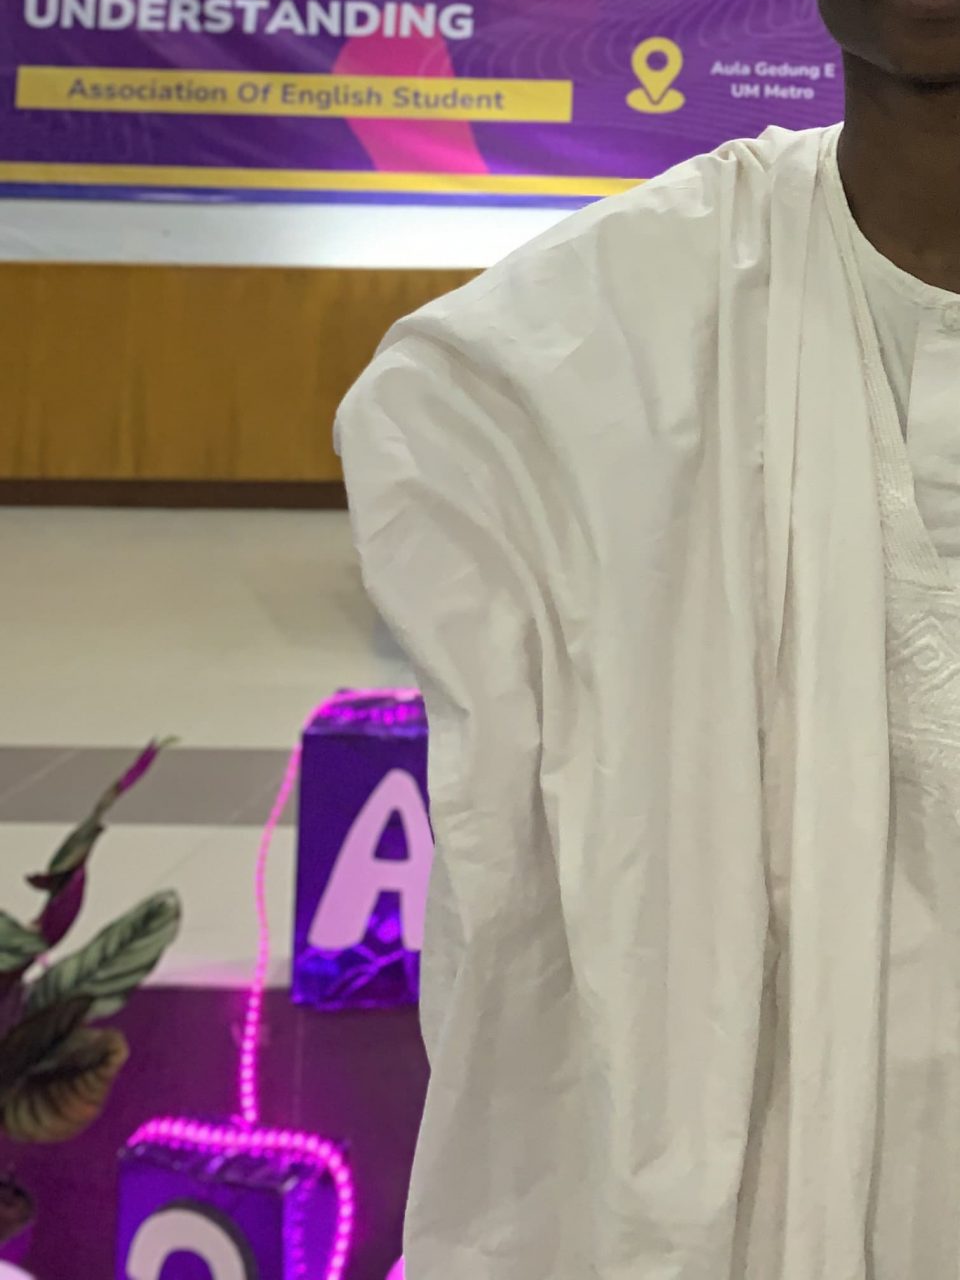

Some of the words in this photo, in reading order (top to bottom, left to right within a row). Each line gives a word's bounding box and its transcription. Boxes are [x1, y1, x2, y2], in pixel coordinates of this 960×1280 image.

[710, 61, 751, 76] Aula
[754, 61, 820, 80] Gedung
[824, 63, 835, 78] E
[67, 77, 227, 104] Association
[237, 83, 270, 104] Of
[281, 83, 383, 109] English
[393, 86, 505, 110] Student
[731, 83, 760, 98] UM
[764, 84, 815, 99] Metro
[307, 768, 434, 951] A
